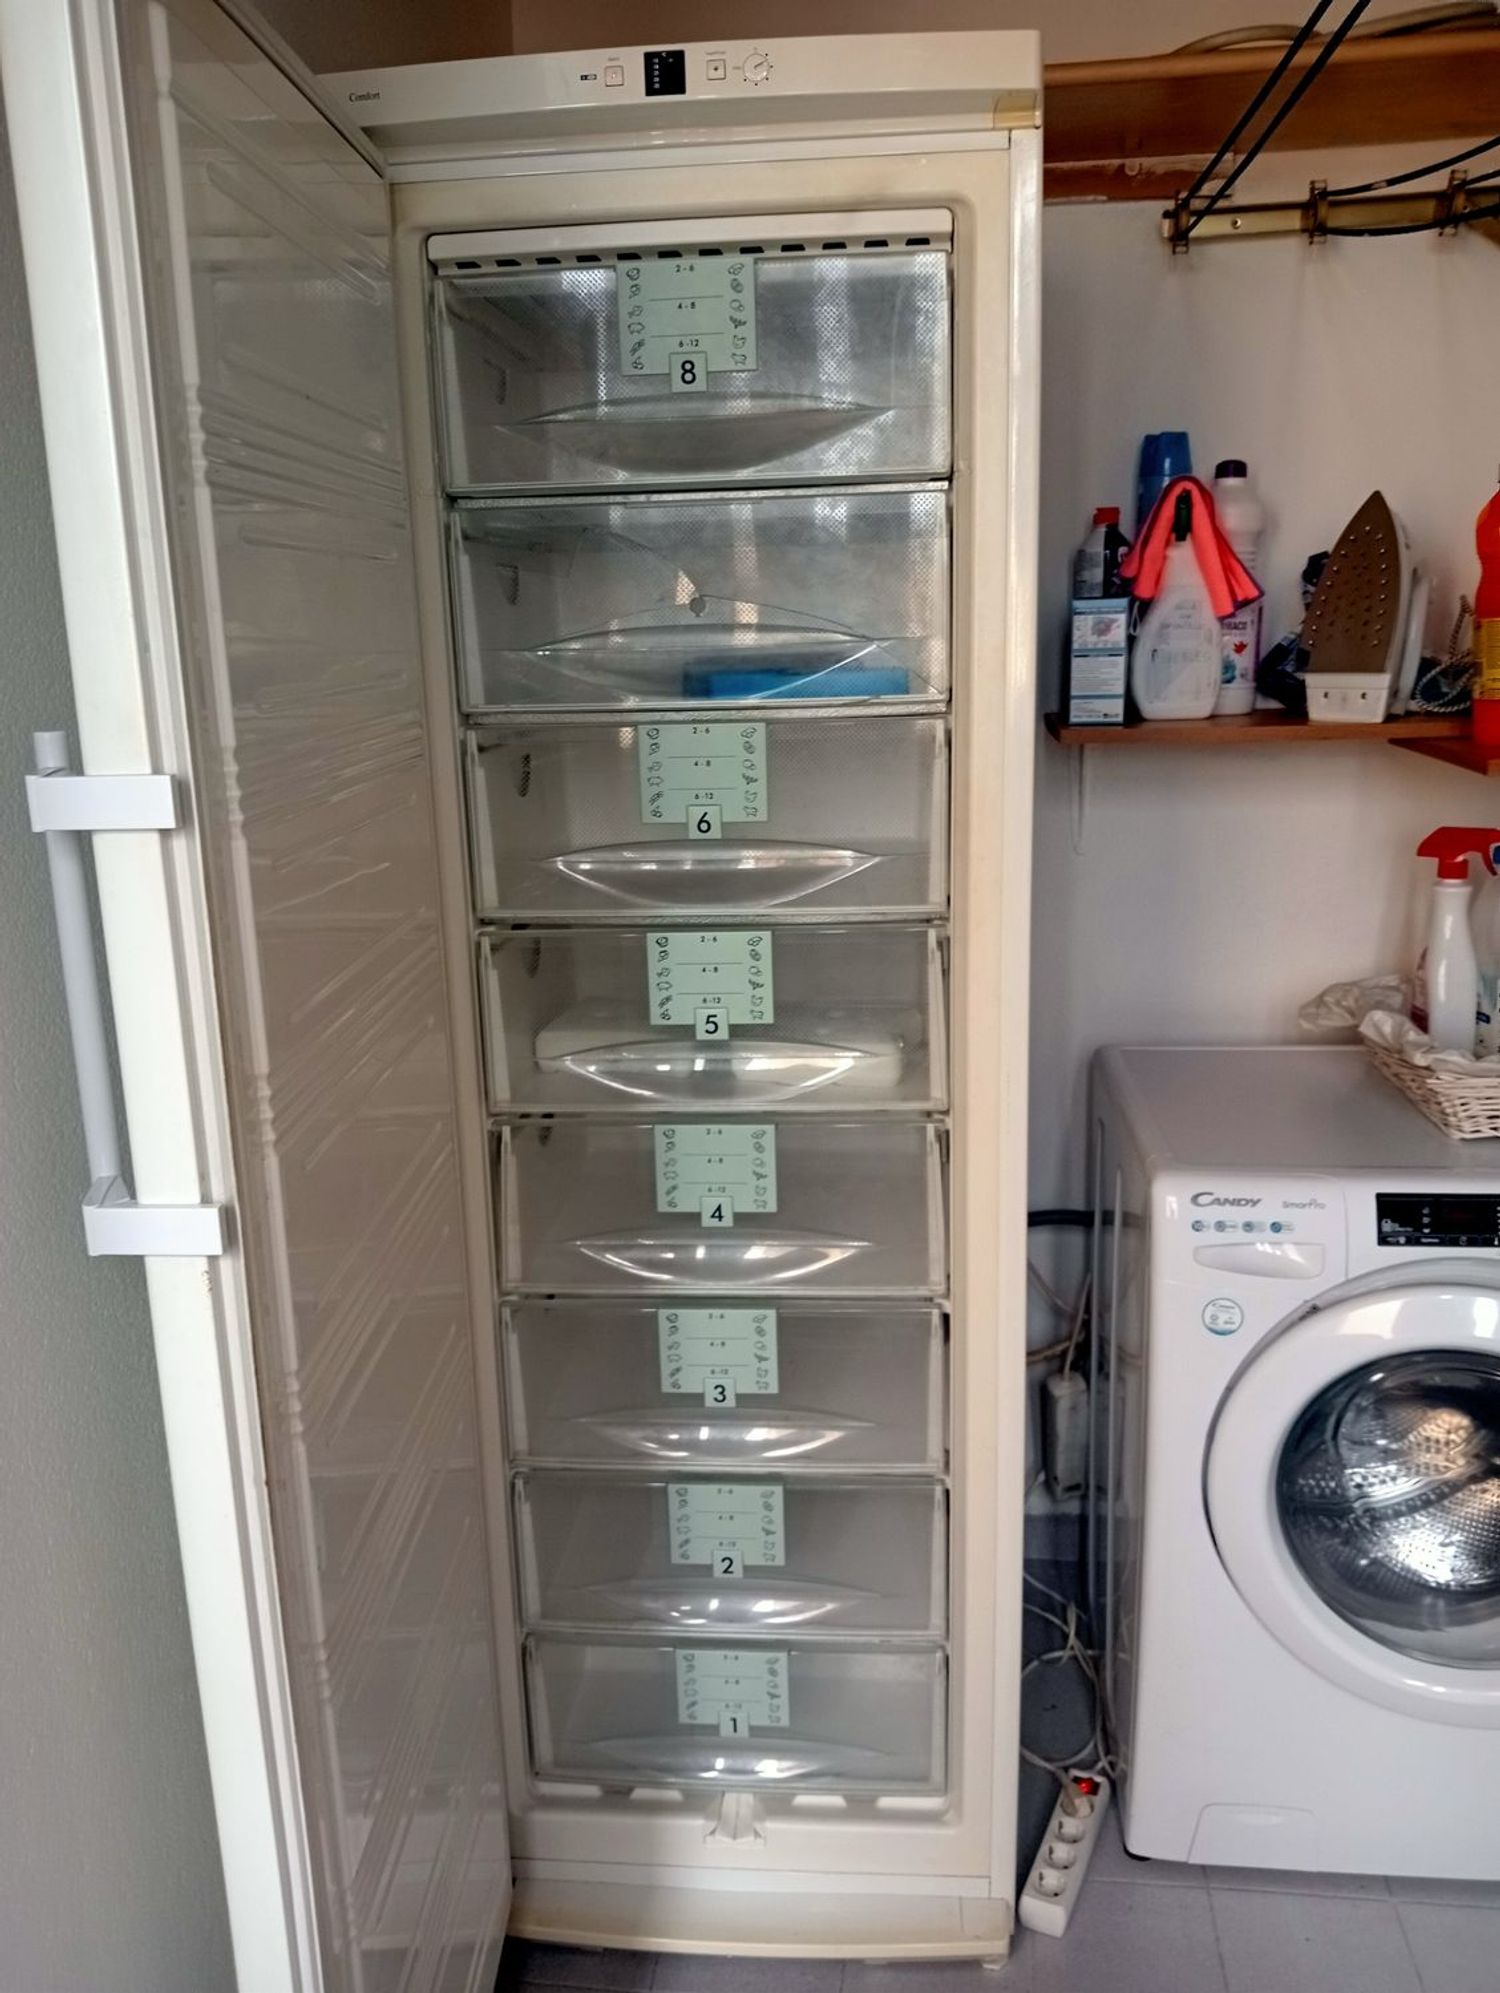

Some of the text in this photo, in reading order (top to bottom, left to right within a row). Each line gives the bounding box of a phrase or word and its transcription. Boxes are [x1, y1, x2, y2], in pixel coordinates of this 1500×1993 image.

[680, 359, 697, 385] 8
[697, 811, 712, 834] 6
[705, 1014, 719, 1034] 5
[1190, 1191, 1262, 1208] CANDY
[710, 1203, 724, 1222] 4
[713, 1384, 727, 1403] 3
[720, 1556, 734, 1574] 2
[729, 1717, 738, 1734] 1
